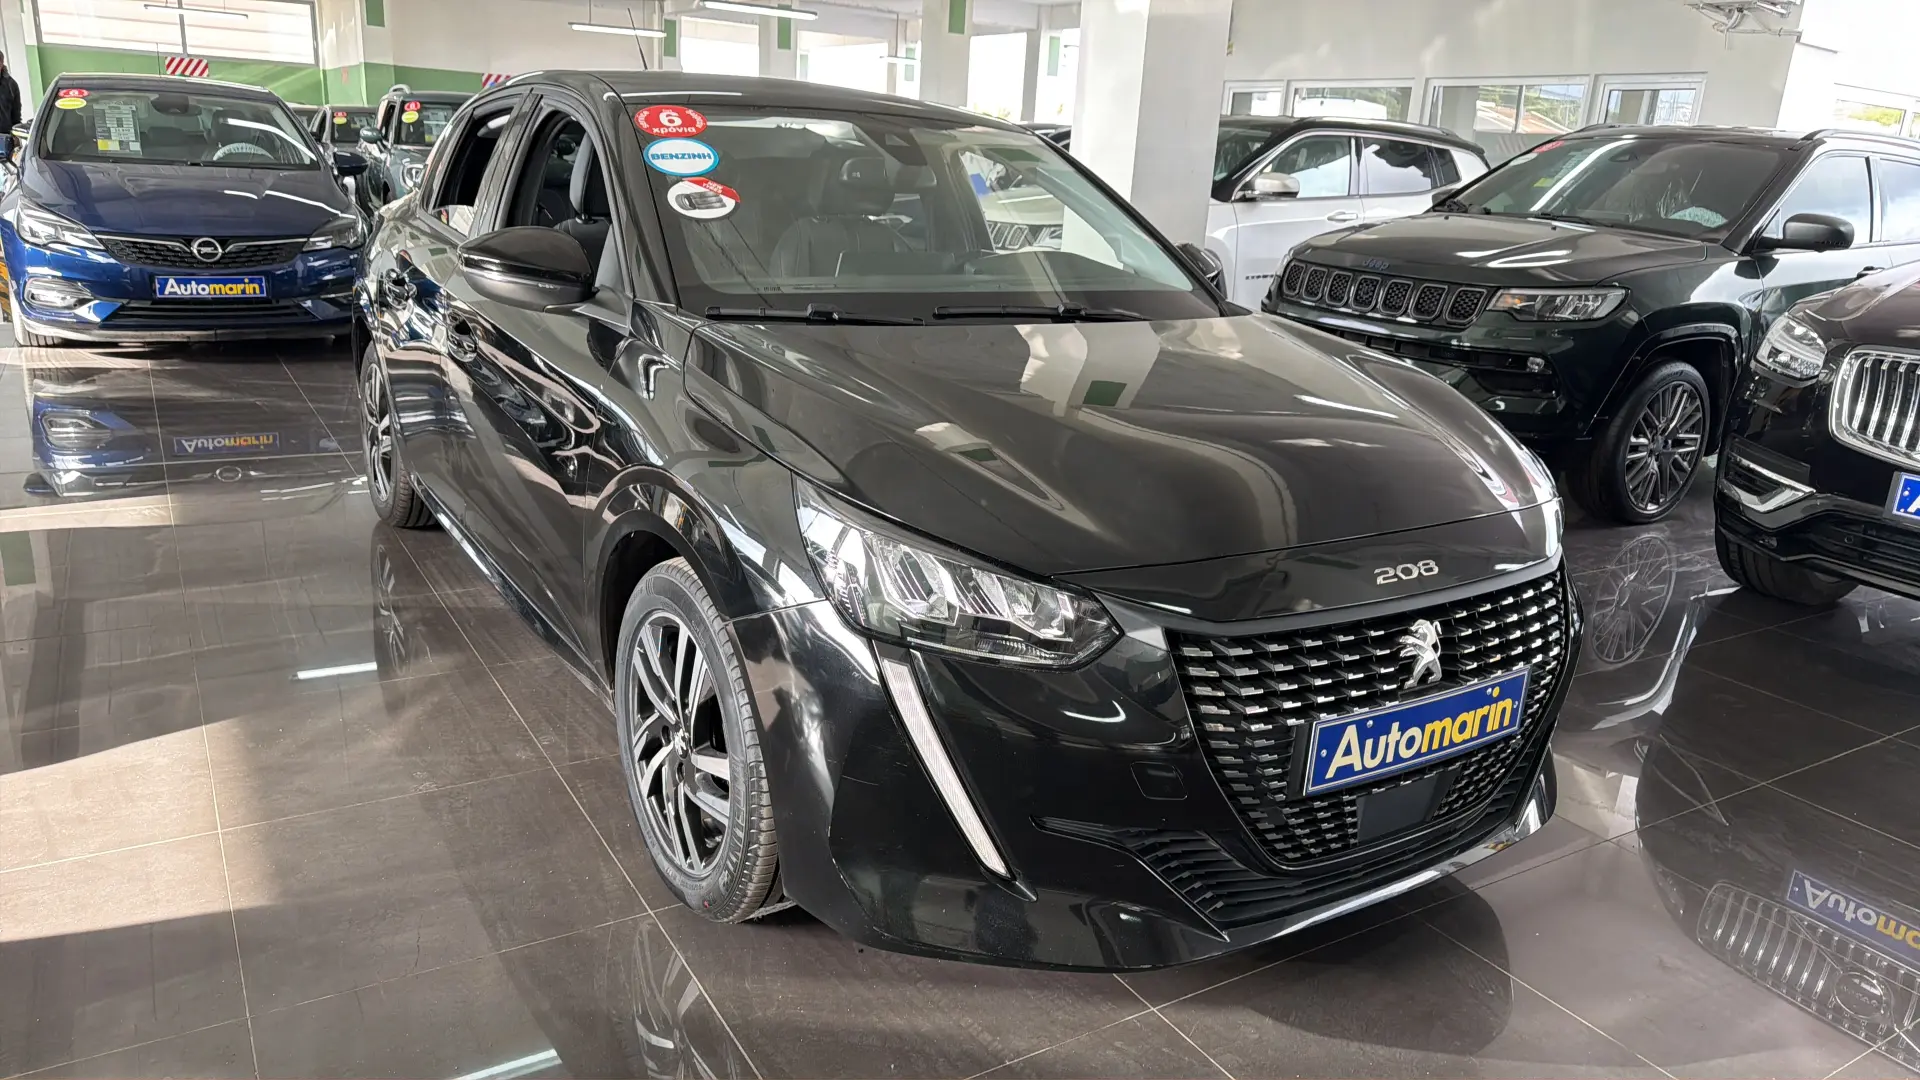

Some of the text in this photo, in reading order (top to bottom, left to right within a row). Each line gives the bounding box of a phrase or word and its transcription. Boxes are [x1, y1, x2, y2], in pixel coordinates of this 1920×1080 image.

[659, 111, 682, 127] 6
[652, 126, 697, 135] χρόνια
[164, 278, 260, 295] Automarin
[1374, 560, 1438, 584] 208
[1325, 687, 1512, 779] Automarin
